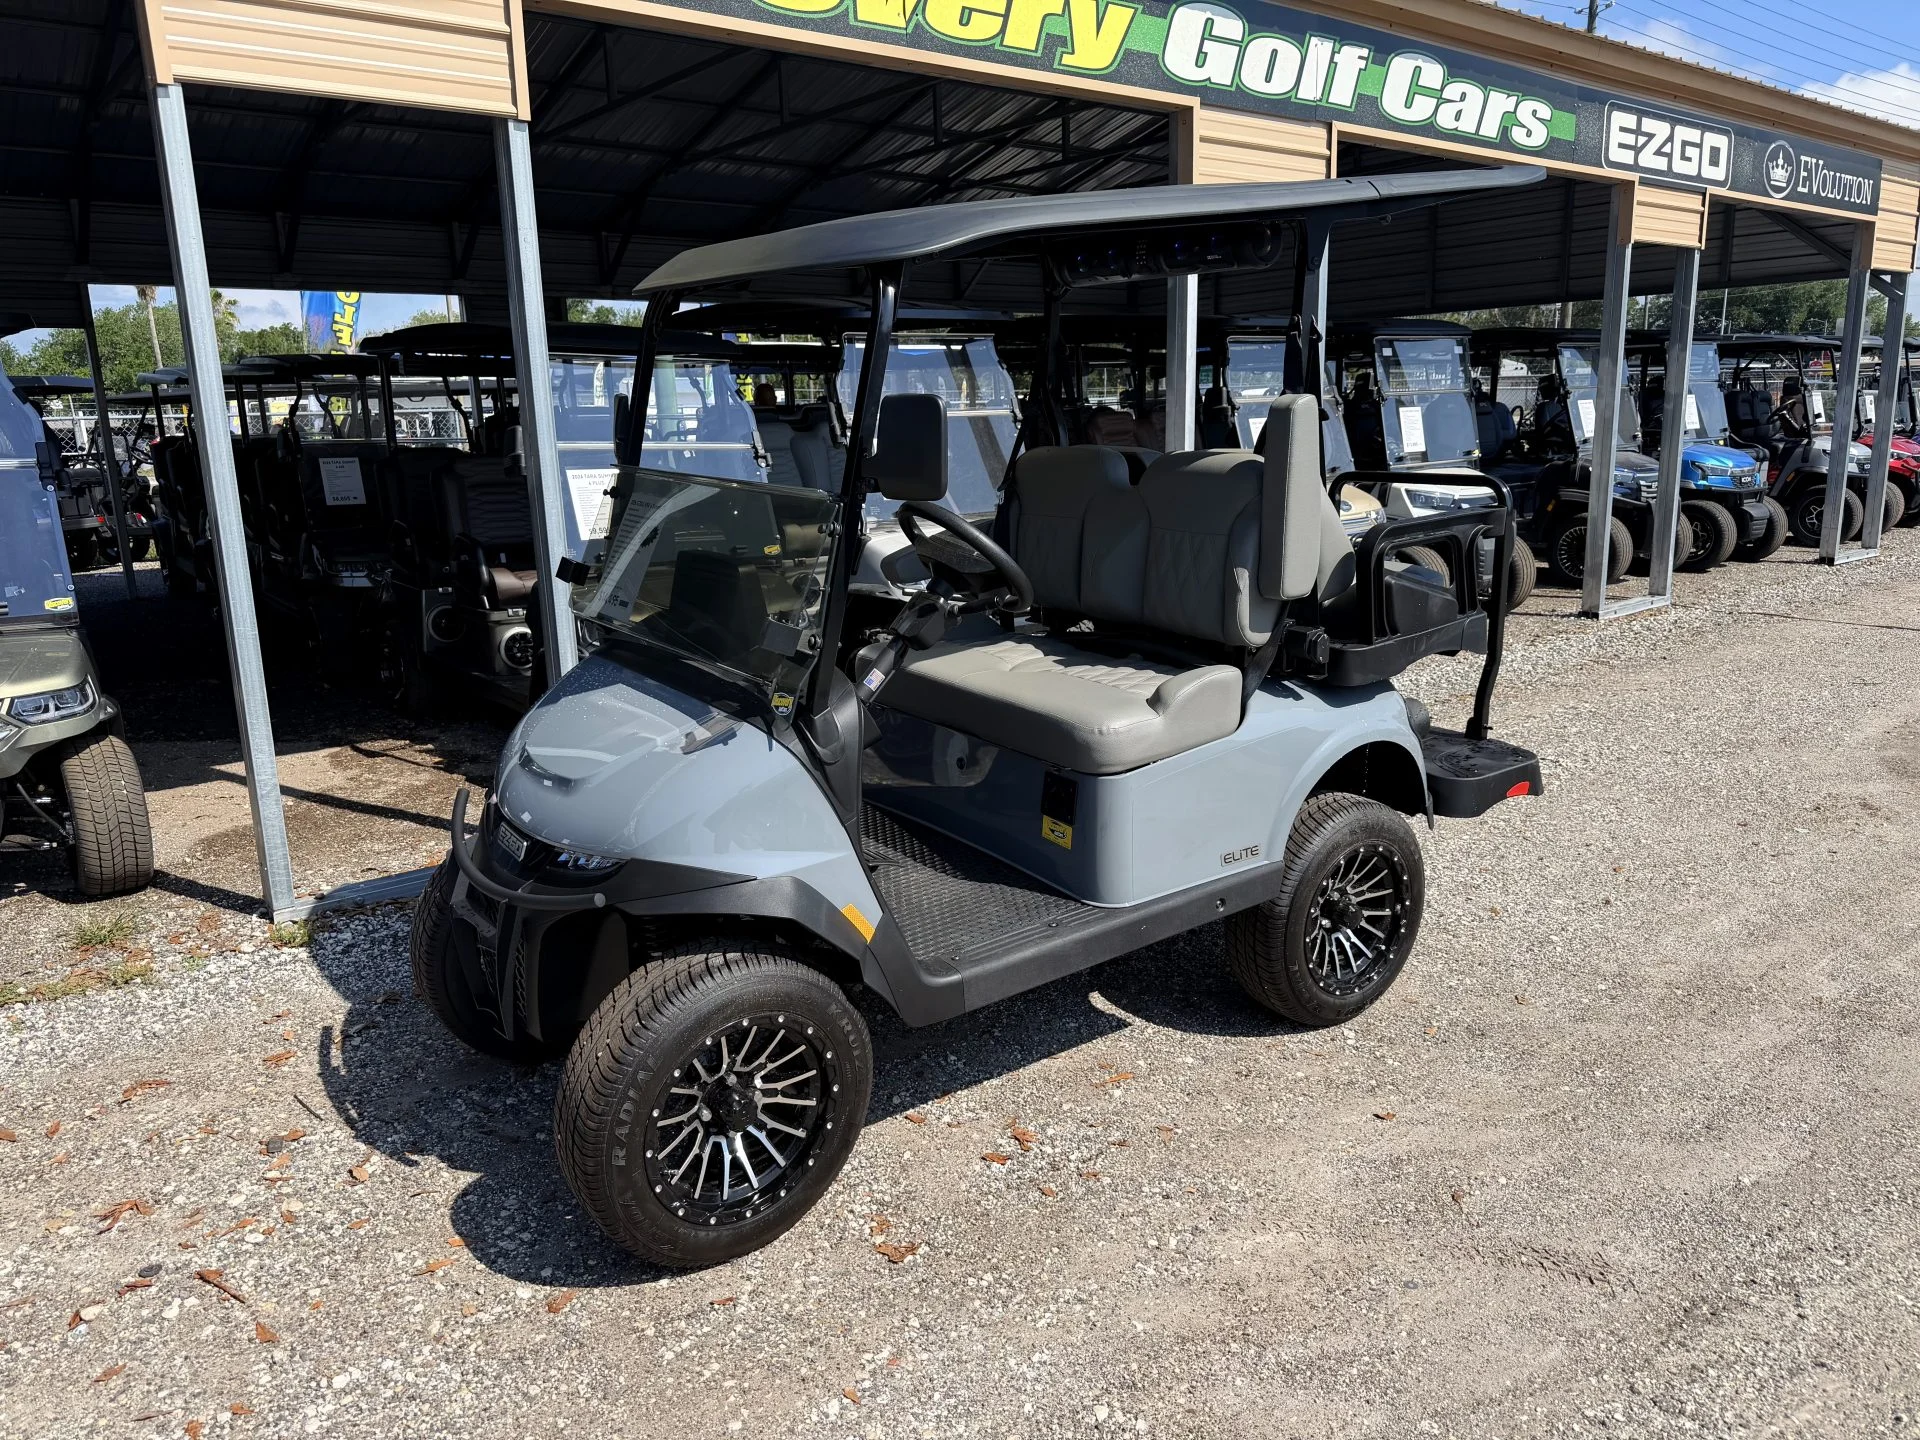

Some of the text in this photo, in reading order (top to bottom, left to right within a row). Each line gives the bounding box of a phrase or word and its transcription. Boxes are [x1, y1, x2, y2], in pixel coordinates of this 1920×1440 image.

[750, 0, 1552, 148] ery Golf Cars
